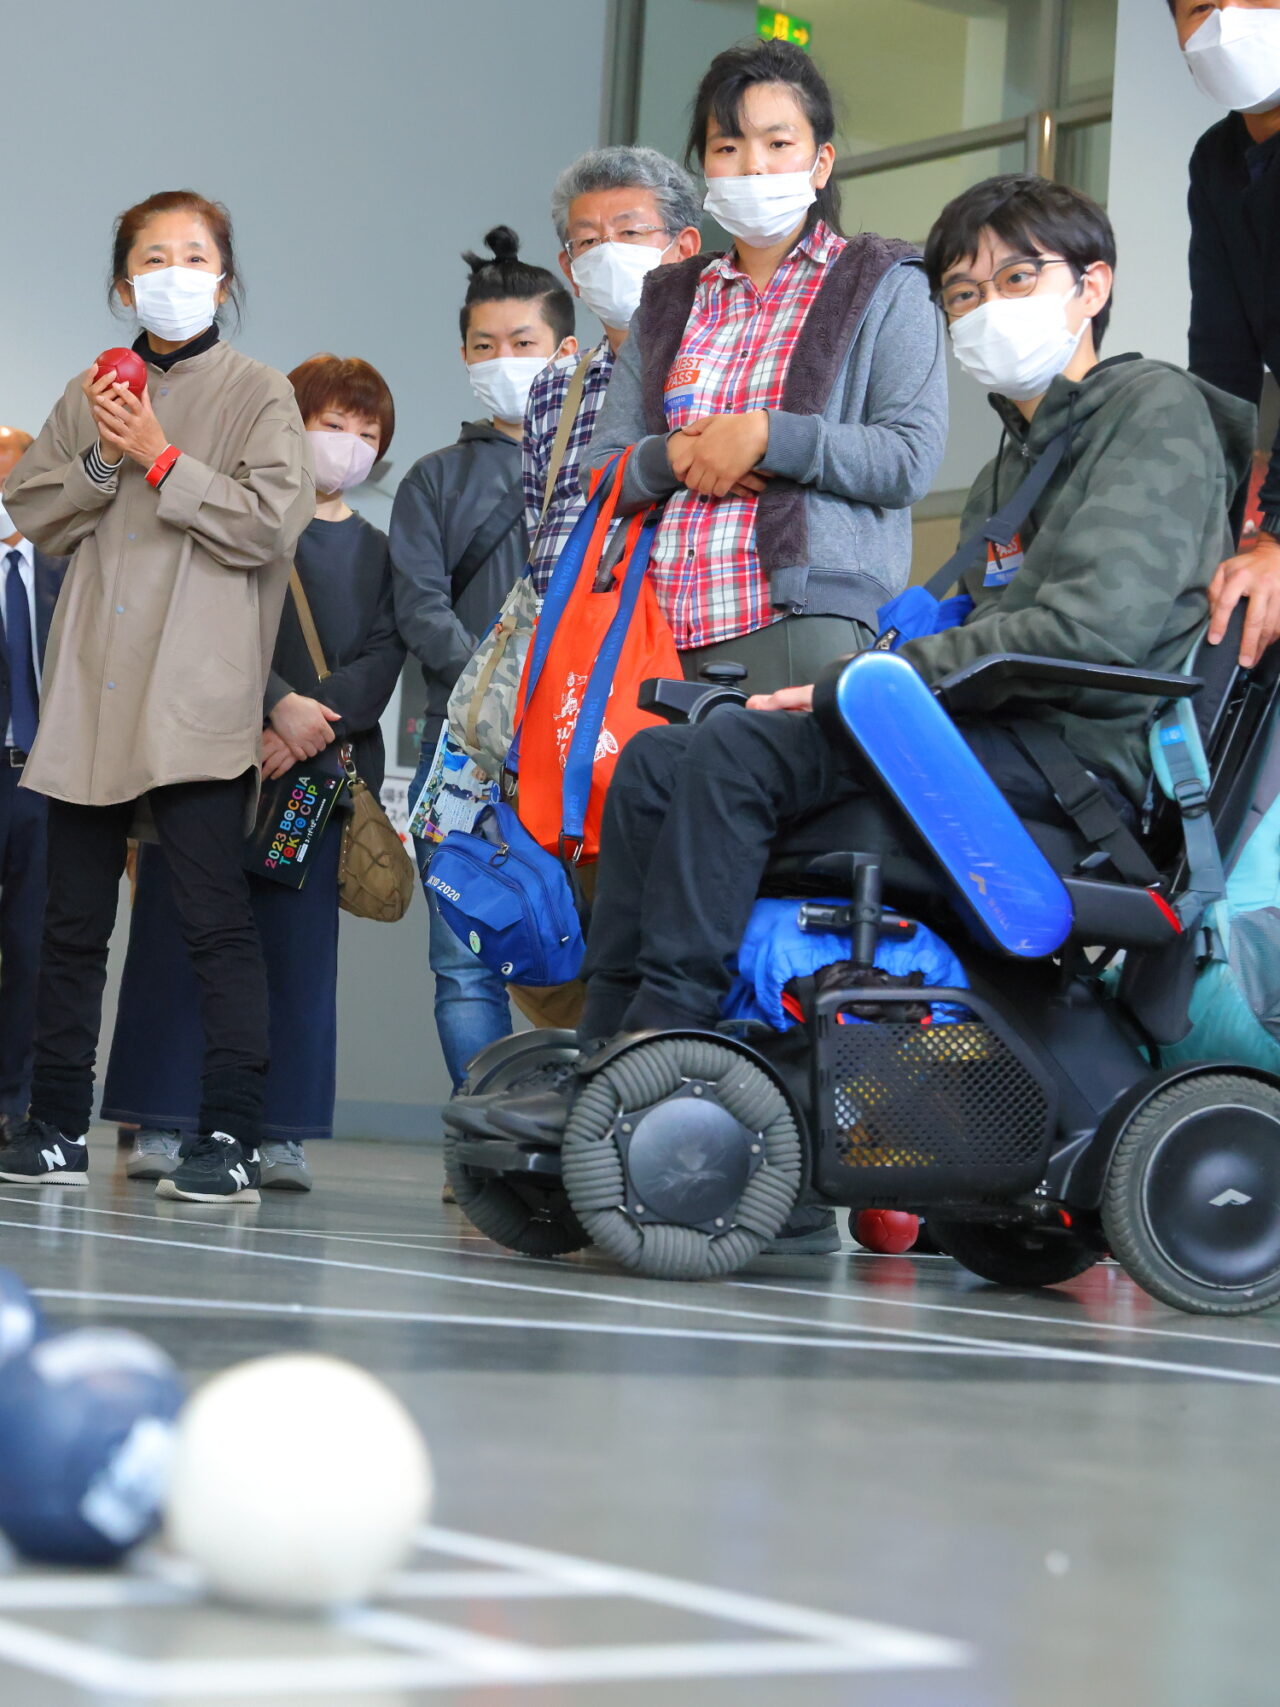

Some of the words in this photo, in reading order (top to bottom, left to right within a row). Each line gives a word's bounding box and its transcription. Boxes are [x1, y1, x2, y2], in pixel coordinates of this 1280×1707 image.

[265, 832, 287, 869] 2023
[279, 776, 311, 831] BOCCIA
[278, 817, 307, 865] TOKYO
[299, 784, 319, 815] CUP
[437, 881, 461, 902] 2020
